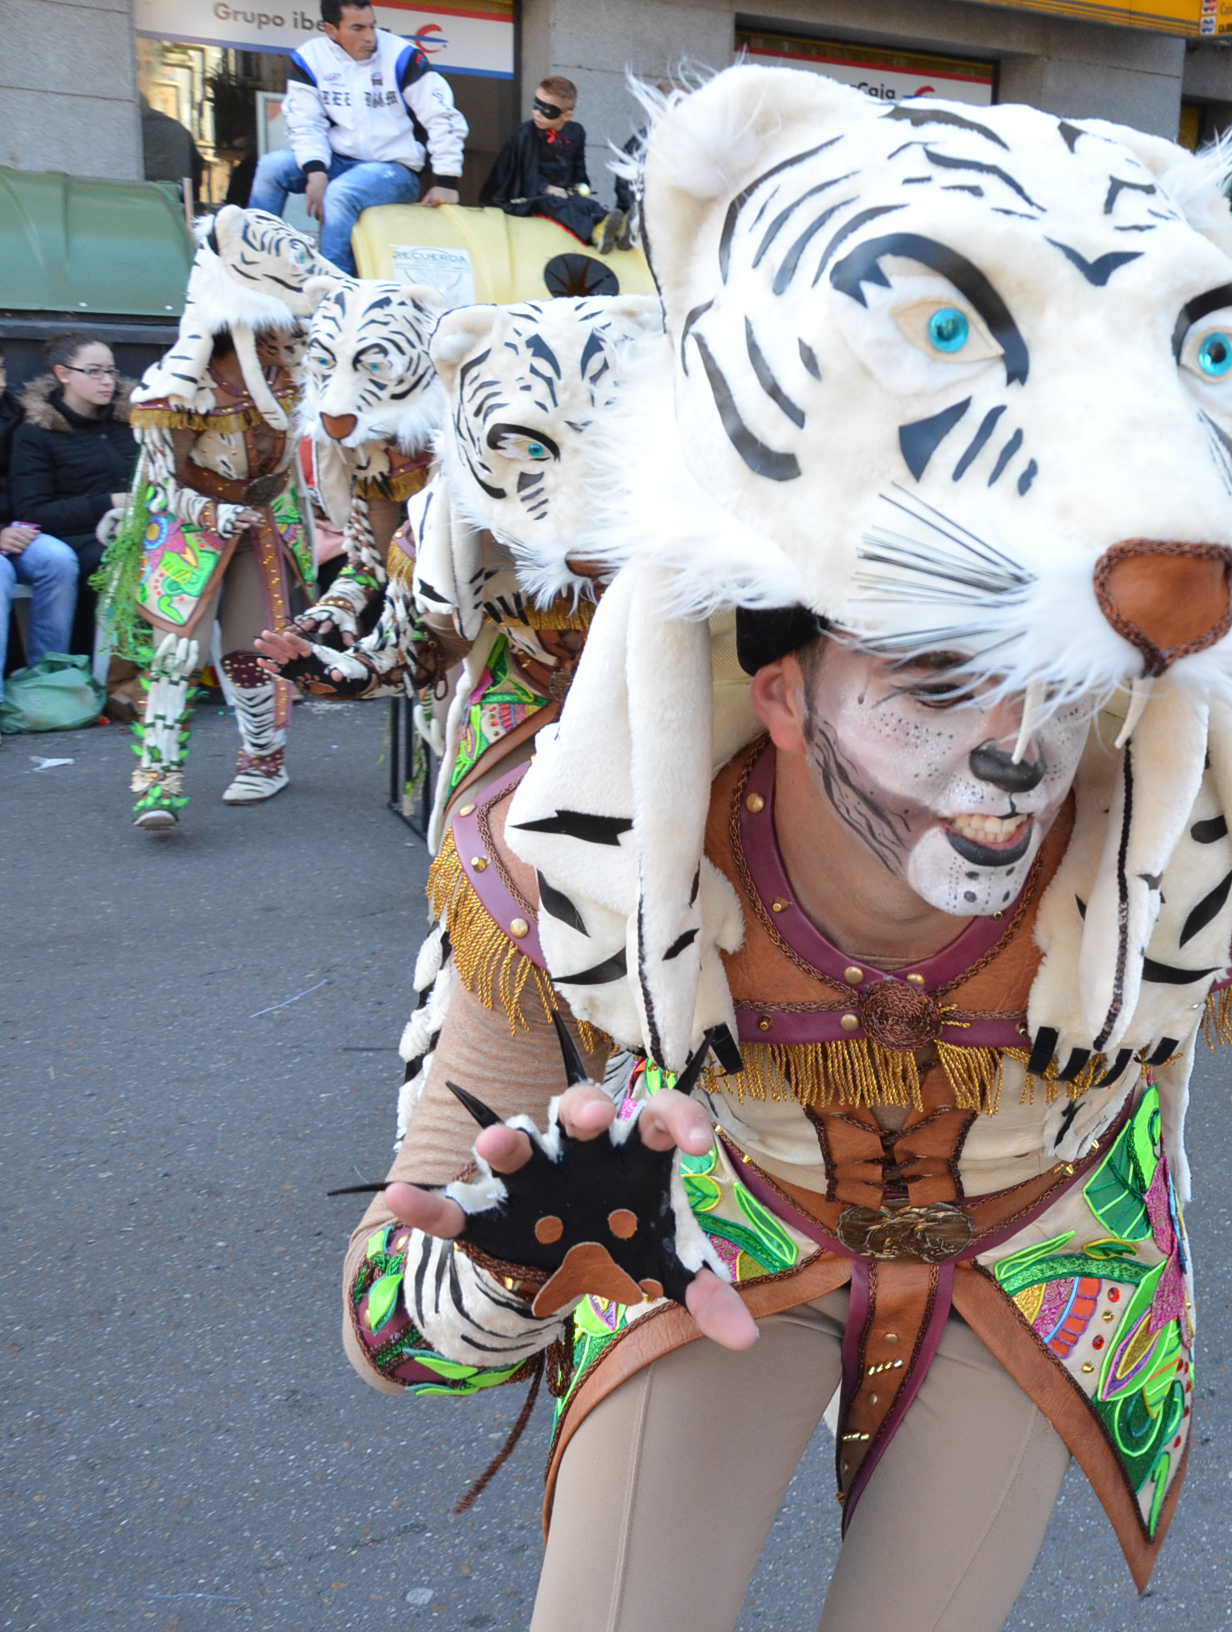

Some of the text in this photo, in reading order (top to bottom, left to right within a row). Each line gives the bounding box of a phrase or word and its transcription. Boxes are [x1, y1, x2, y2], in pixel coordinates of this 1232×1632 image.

[214, 3, 327, 32] Grupo ibe
[850, 81, 896, 100] Caja
